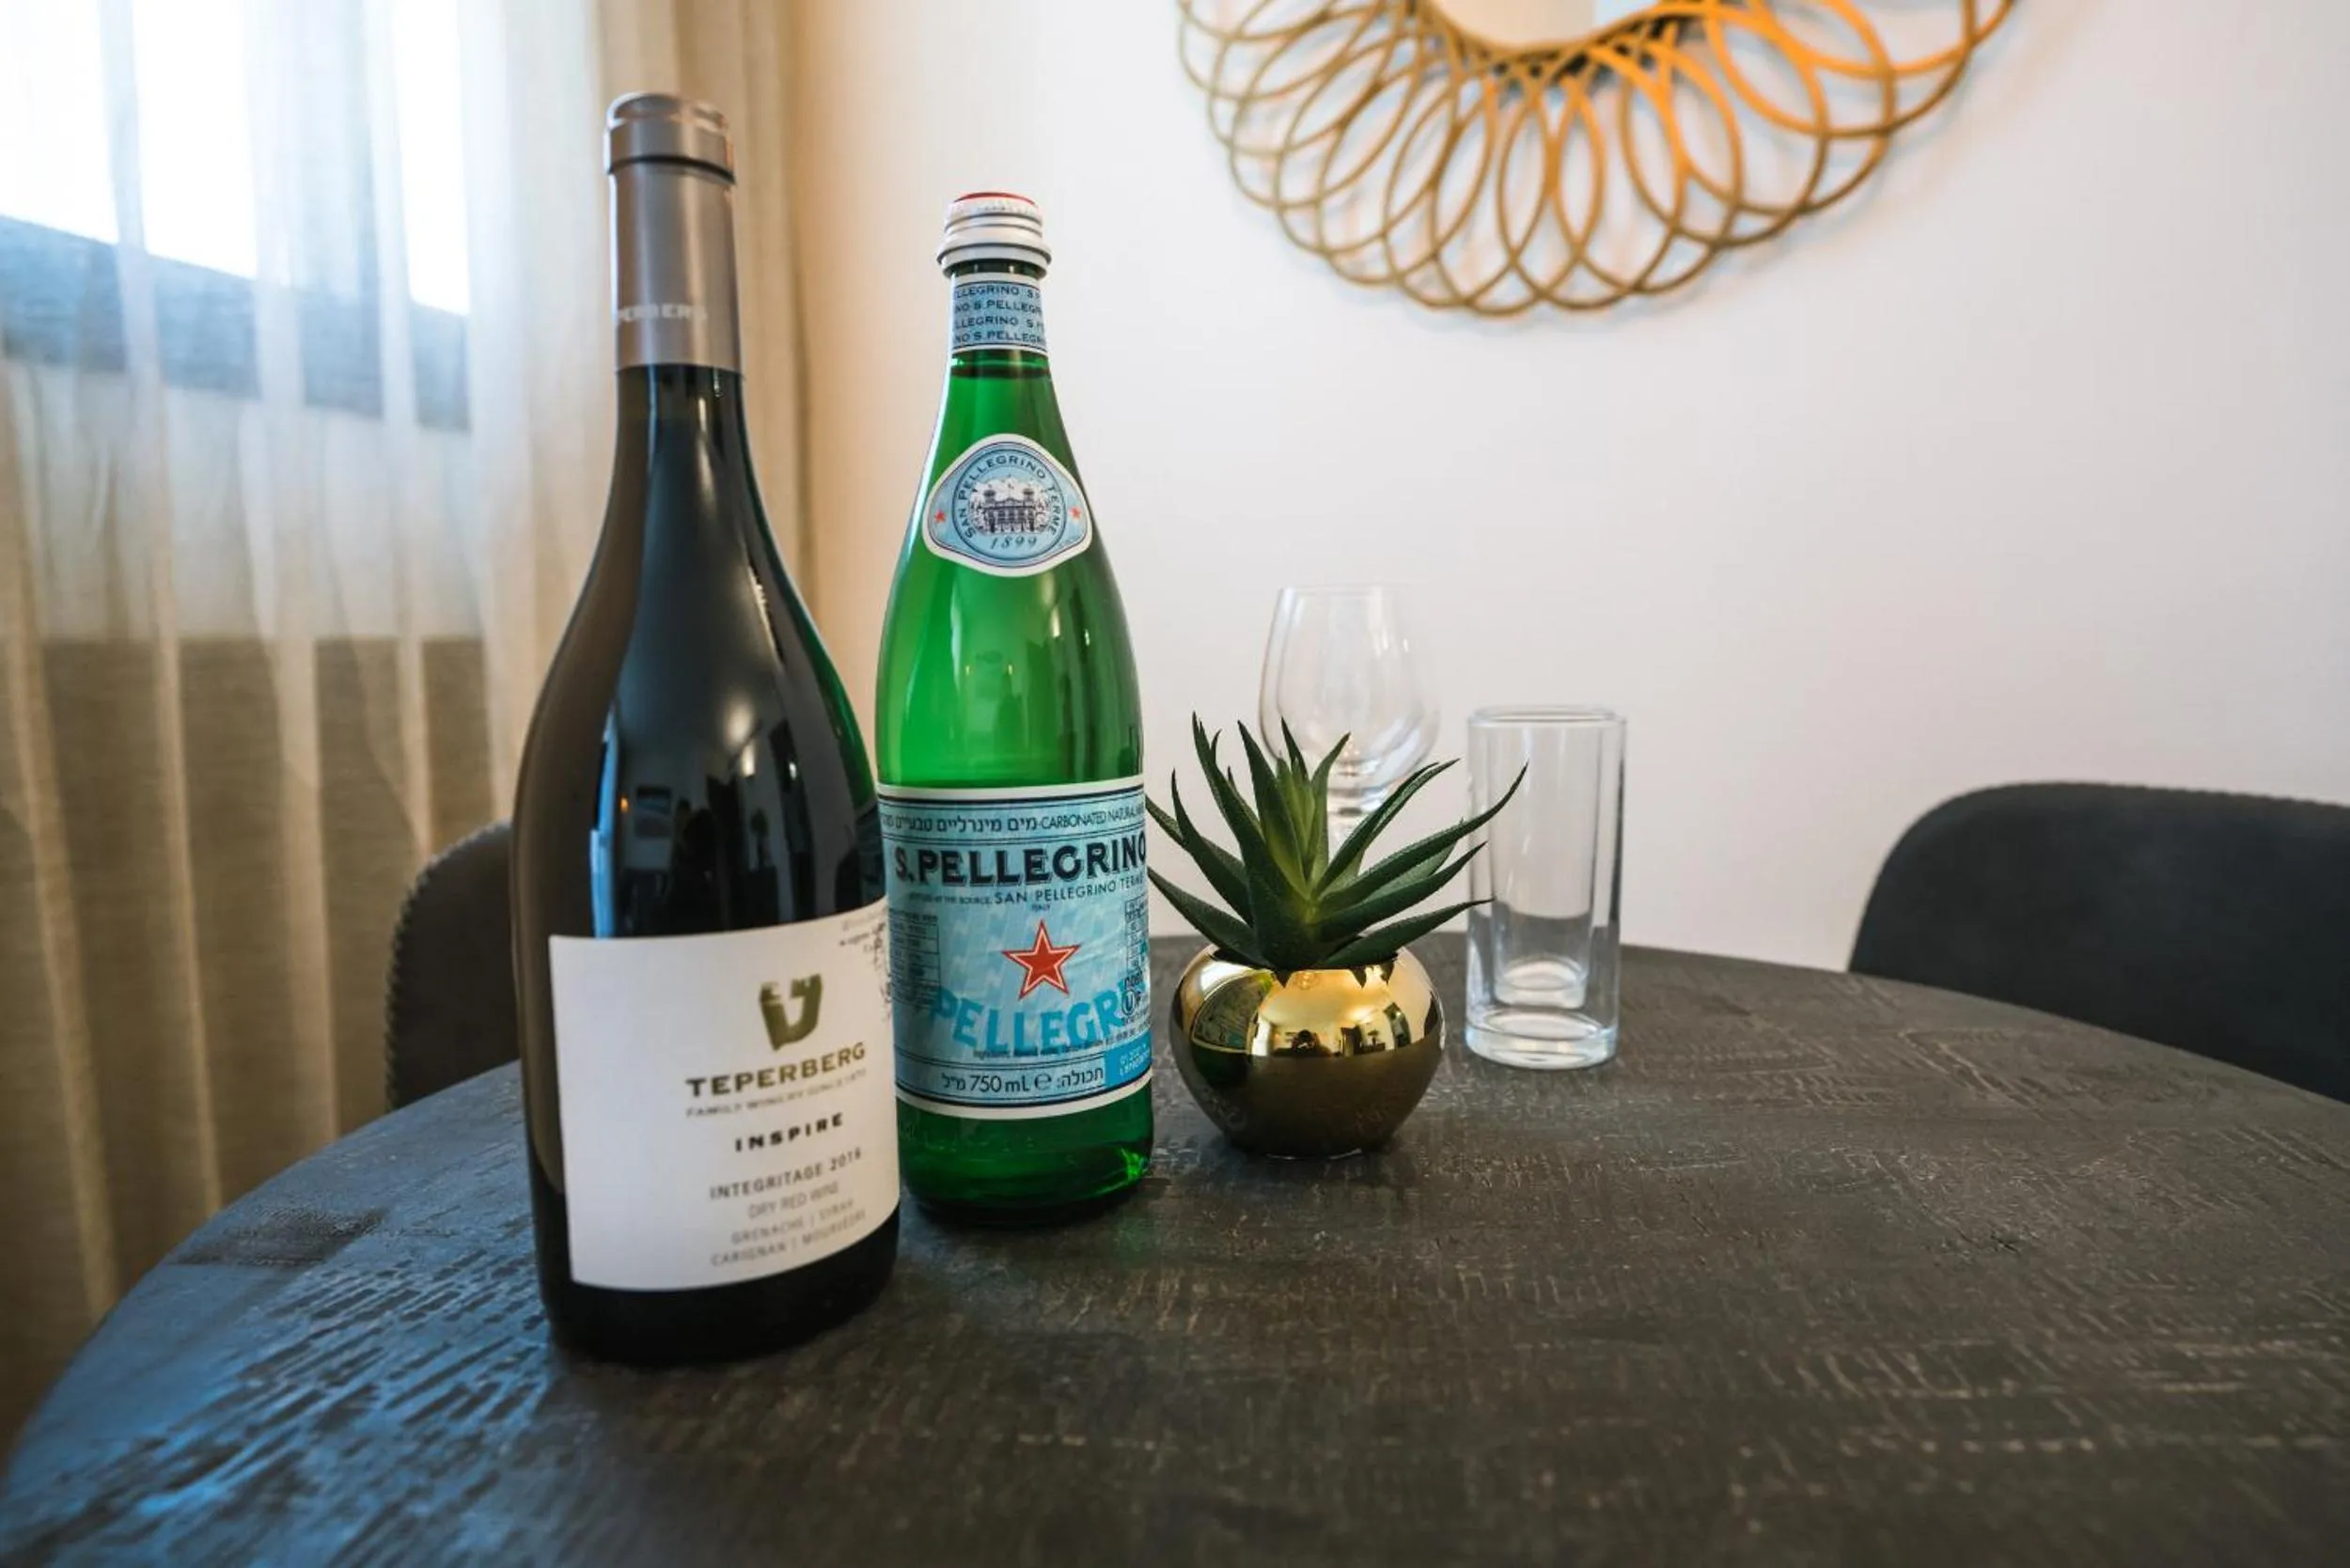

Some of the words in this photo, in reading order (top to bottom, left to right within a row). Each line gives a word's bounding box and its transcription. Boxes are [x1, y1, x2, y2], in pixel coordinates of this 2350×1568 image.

[958, 455, 1046, 500] PELLEGRINO
[1046, 485, 1061, 536] TERME
[959, 510, 976, 539] SAN
[991, 535, 1038, 550] 1899
[1008, 816, 1036, 831] מים
[1042, 811, 1106, 829] CARBONATED
[995, 892, 1027, 904] SAN
[1035, 880, 1117, 902] PELLEGRINO
[684, 1042, 866, 1097] TEPERBERG
[969, 1074, 1001, 1093] 750
[735, 1113, 843, 1152] INSPIRE
[710, 1163, 822, 1200] INTEGRITAGE
[780, 1191, 807, 1210] RED
